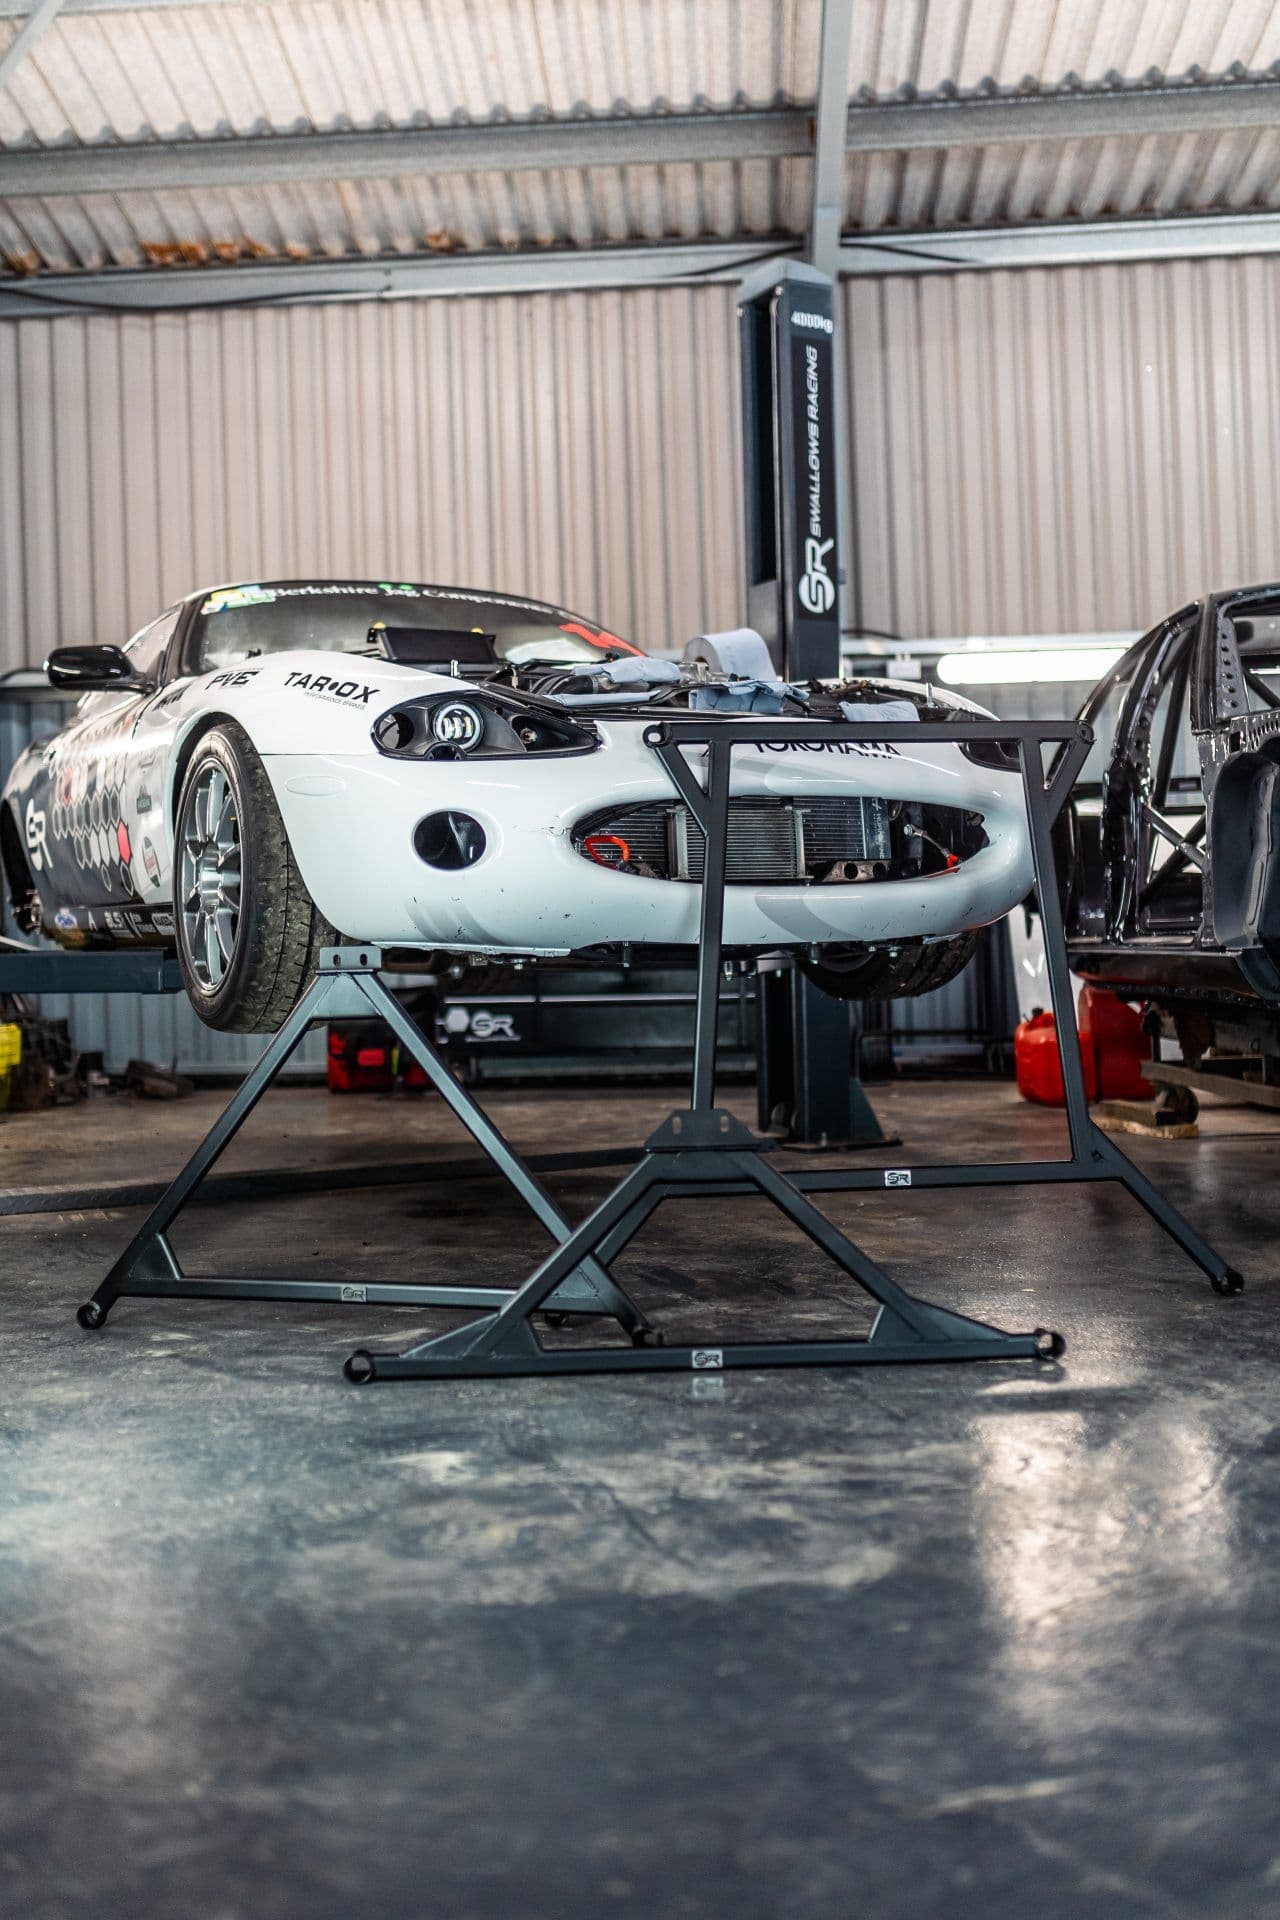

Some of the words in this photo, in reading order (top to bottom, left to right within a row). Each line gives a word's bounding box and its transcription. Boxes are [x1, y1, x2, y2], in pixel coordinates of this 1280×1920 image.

[806, 344, 819, 421] RACING
[808, 421, 821, 537] SWALLOWS
[799, 538, 835, 613] SR
[471, 1012, 515, 1037] SR
[888, 1172, 910, 1185] SR
[695, 1352, 720, 1367] SR
